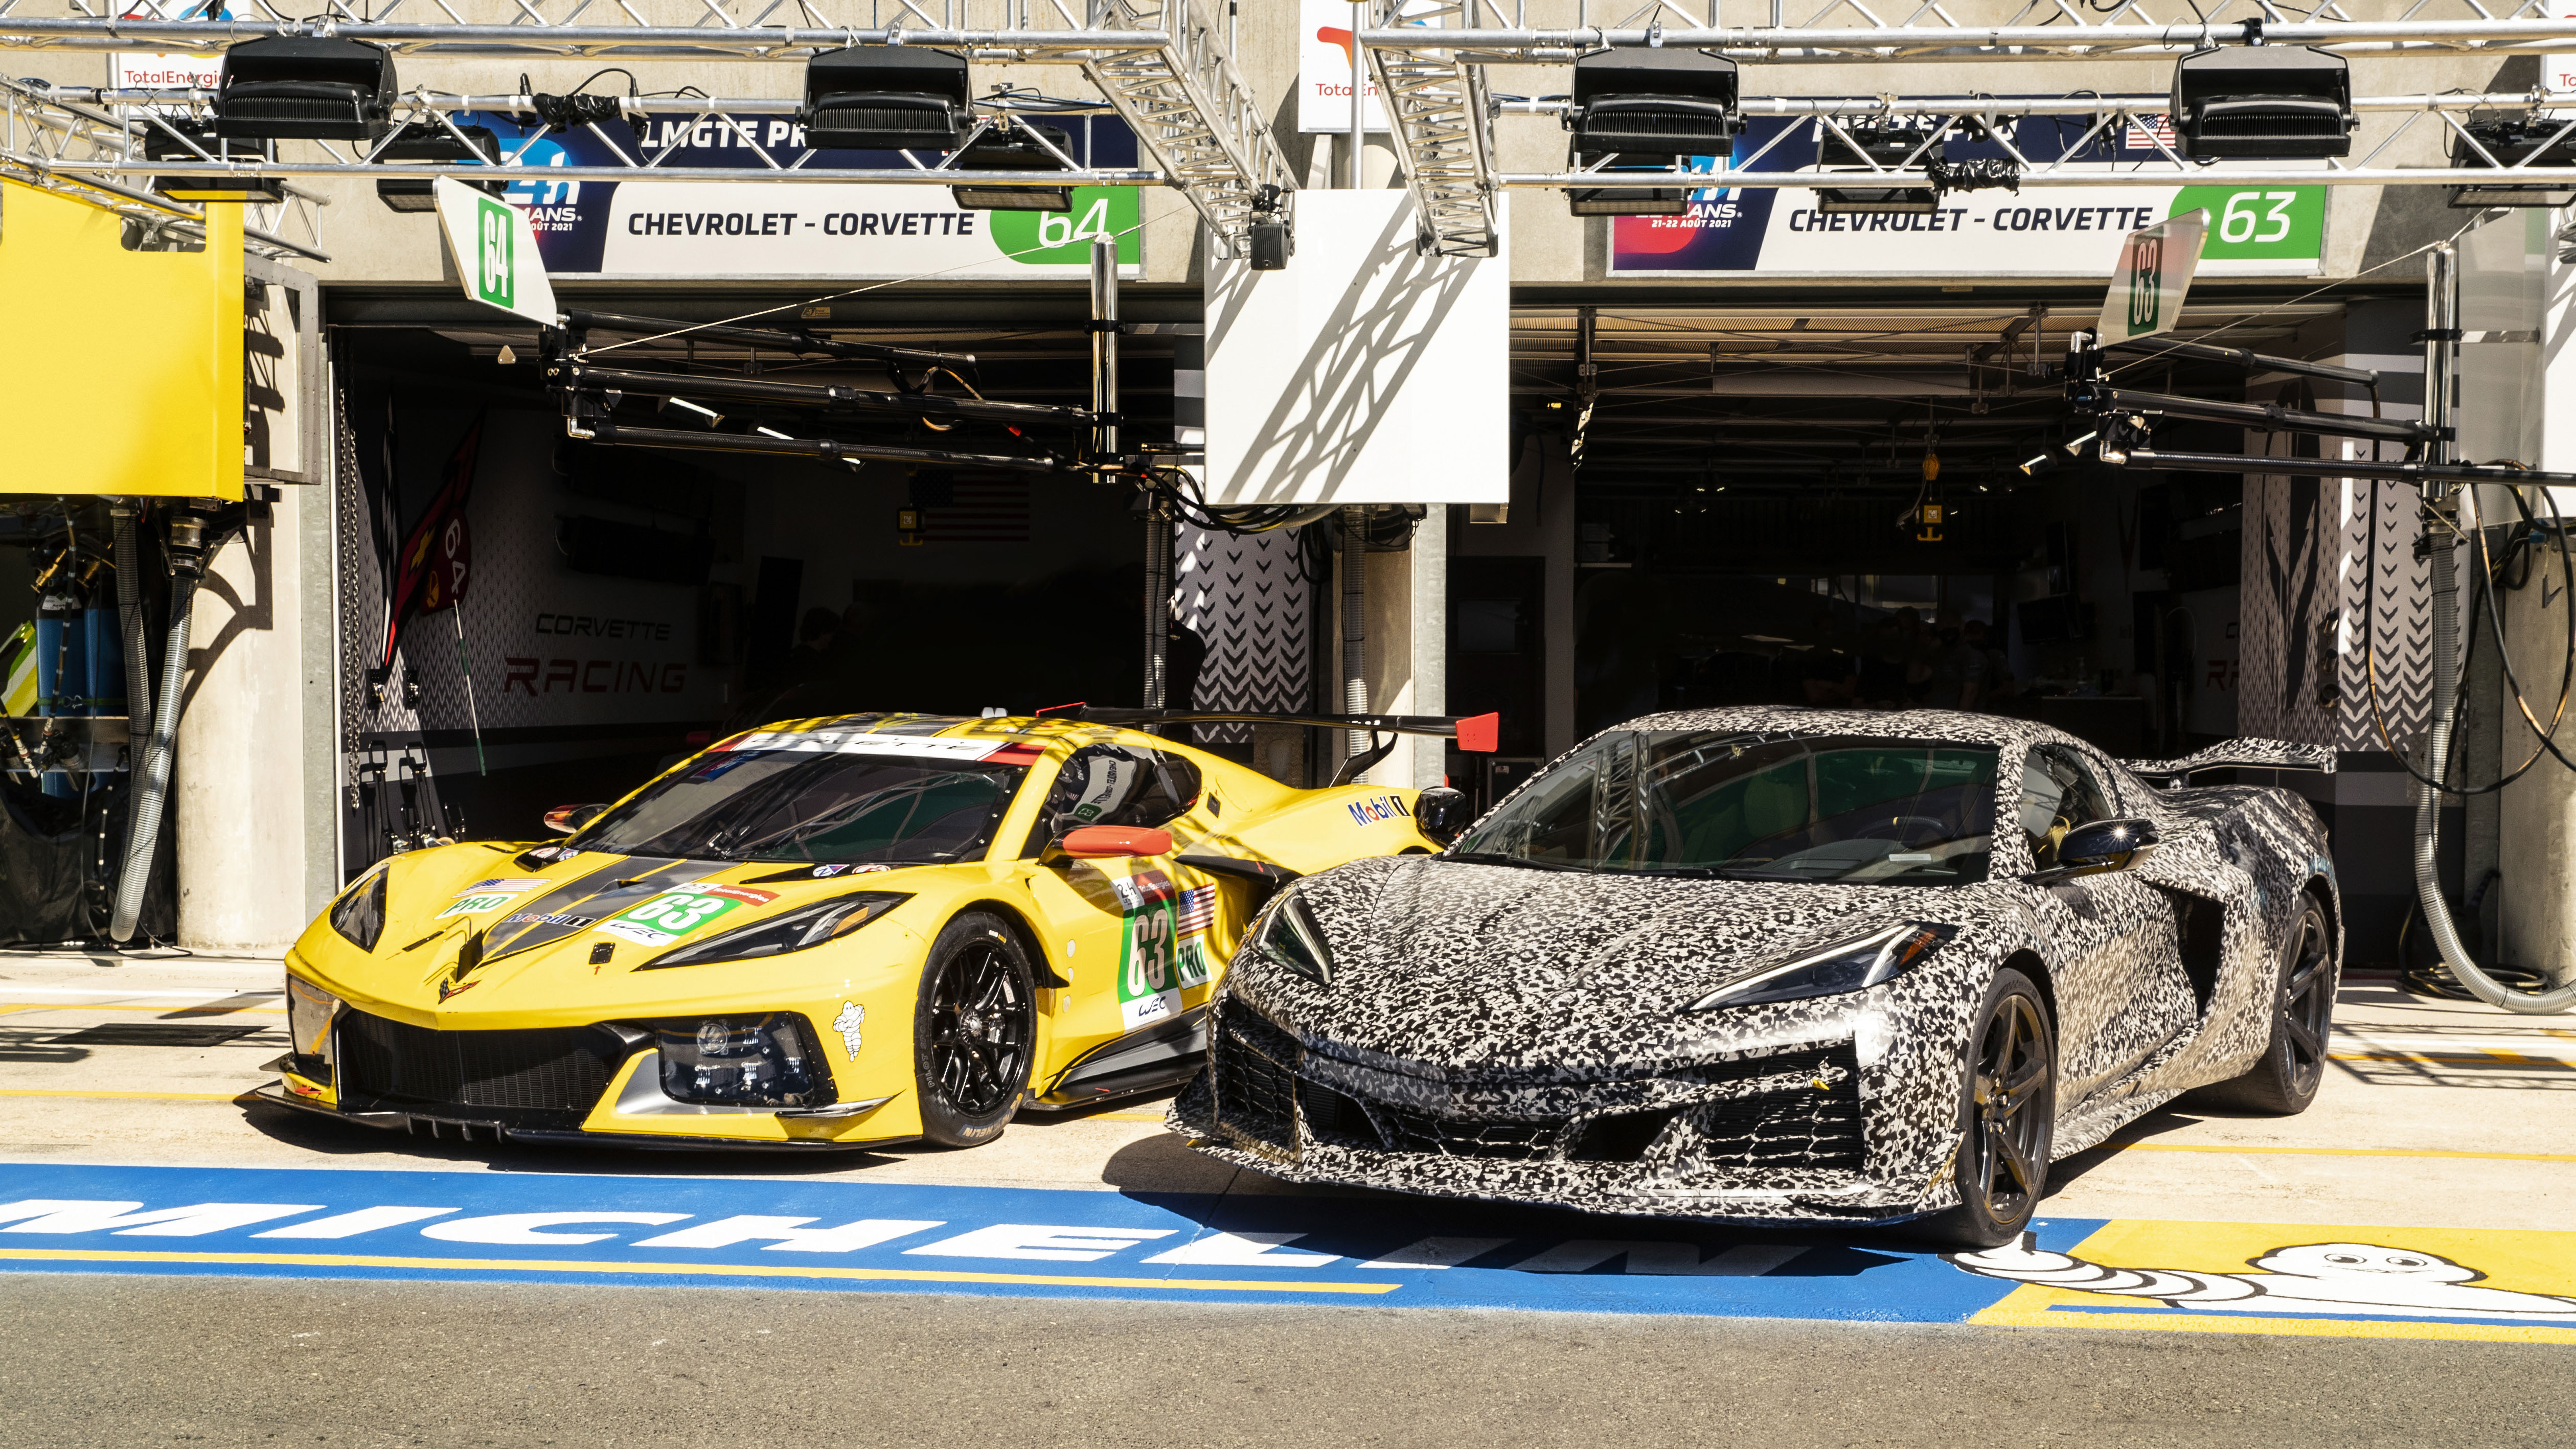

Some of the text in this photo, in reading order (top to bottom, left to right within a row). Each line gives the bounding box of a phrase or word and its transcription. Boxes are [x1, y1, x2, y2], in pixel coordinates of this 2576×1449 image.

[552, 223, 573, 231] 2021
[628, 213, 798, 236] CHEVROLET
[823, 213, 975, 236] CORVETTE
[1038, 198, 1110, 248] 64
[1651, 218, 1731, 227] 21-22 AOÛT 2021
[1789, 209, 1968, 232] CHEVROLET
[1993, 208, 2153, 231] CORVETTE
[2220, 191, 2296, 243] 63
[484, 209, 509, 298] 64
[2134, 238, 2158, 326] 63
[537, 613, 671, 641] CORVETTE
[504, 657, 688, 697] RACING
[751, 737, 984, 752] CORVETTE
[1348, 796, 1398, 826] Mobil
[713, 887, 769, 903] TotalEnergies
[1138, 880, 1171, 893] TotalEnergies
[442, 896, 509, 915] PRO
[503, 913, 572, 924] Mobil
[627, 894, 726, 930] 63
[610, 923, 668, 939] WEC
[1127, 909, 1169, 997] 63
[1177, 941, 1207, 982] PRO
[1138, 996, 1166, 1017] WEC
[921, 1053, 935, 1088] PILOT
[0, 1199, 1814, 1277] MICHELIN
